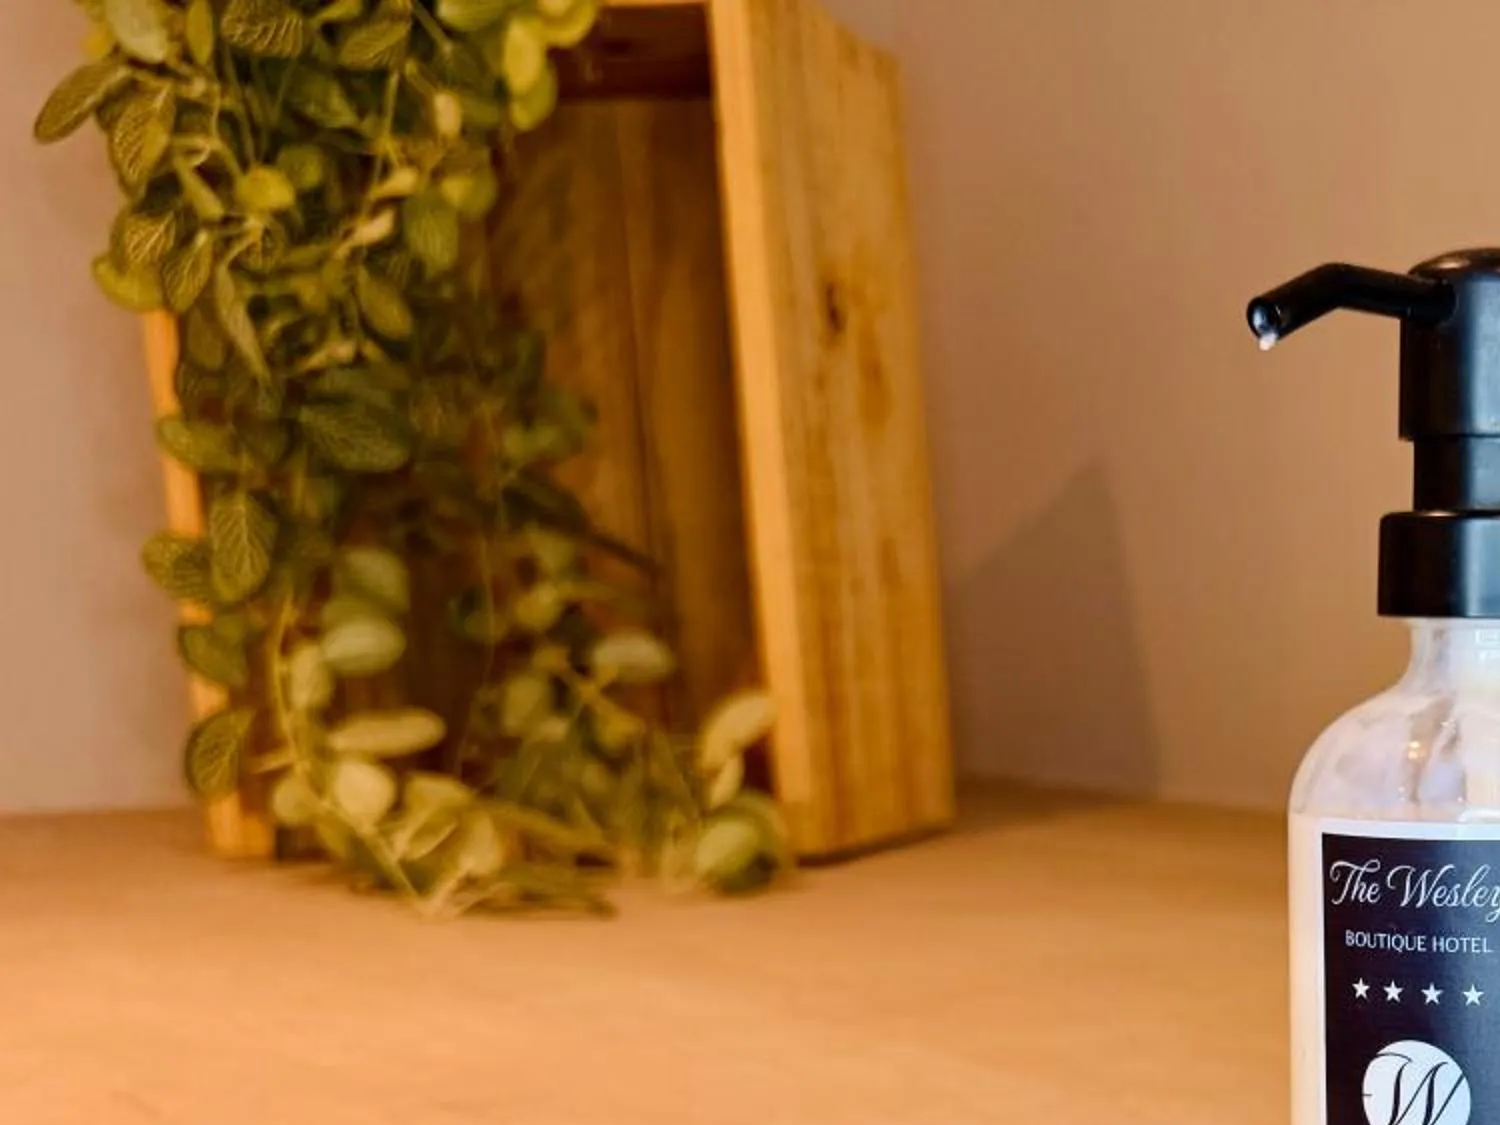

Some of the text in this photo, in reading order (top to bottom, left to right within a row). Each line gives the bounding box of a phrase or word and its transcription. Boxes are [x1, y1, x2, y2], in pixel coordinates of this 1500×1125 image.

[1330, 859, 1380, 904] The
[1346, 930, 1493, 955] BOUTIQUE HOTEL
